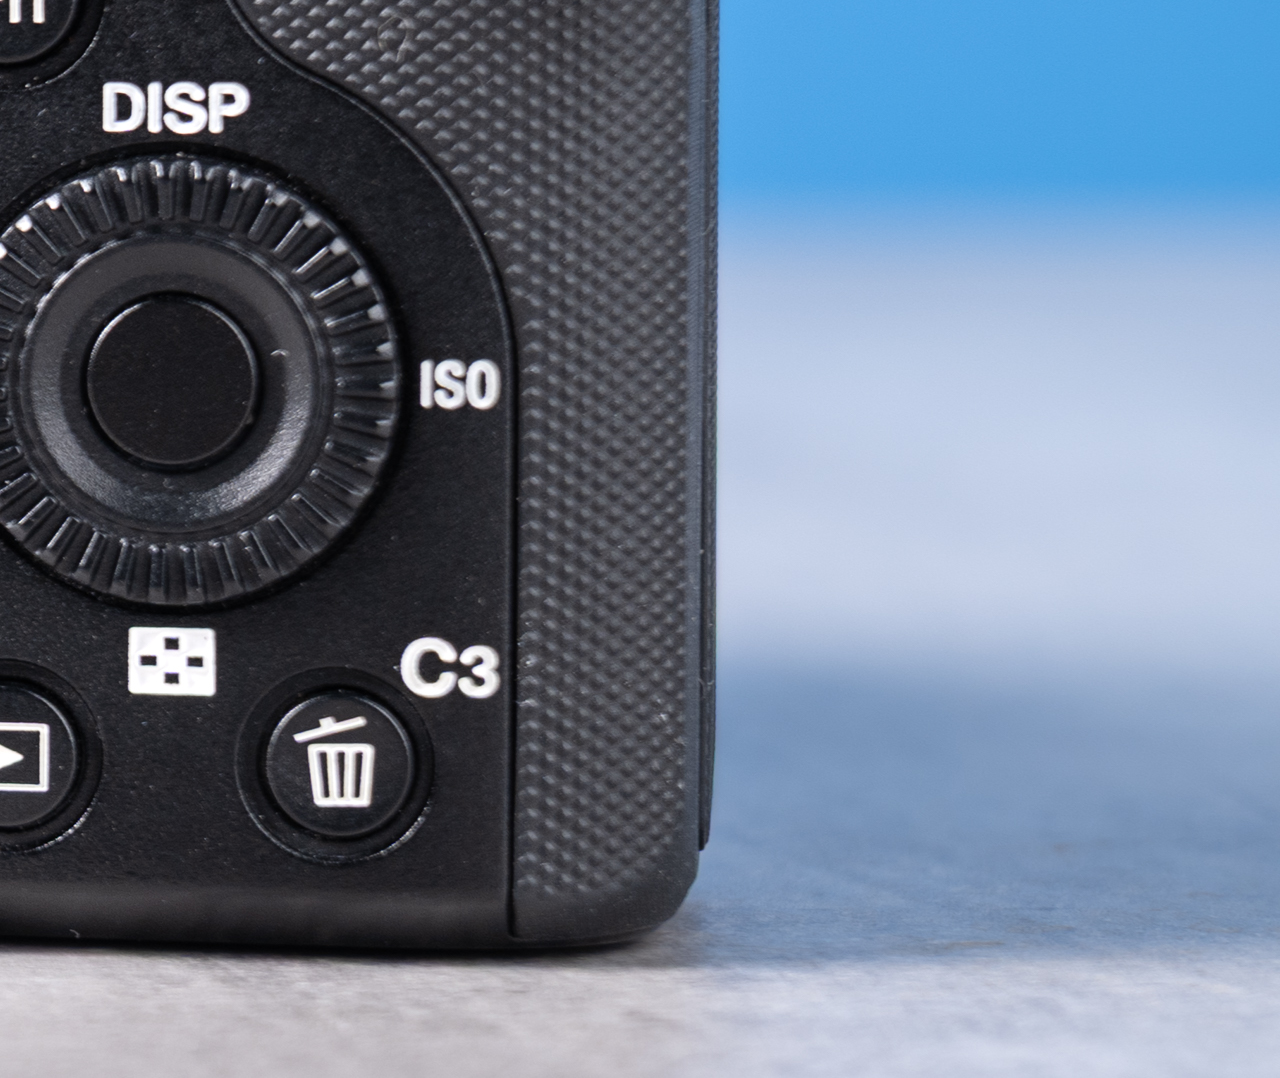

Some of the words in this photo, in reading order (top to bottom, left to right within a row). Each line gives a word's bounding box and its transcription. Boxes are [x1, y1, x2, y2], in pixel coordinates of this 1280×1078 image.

[101, 80, 252, 135] DISP
[419, 358, 502, 411] ISO
[400, 636, 501, 700] C3
